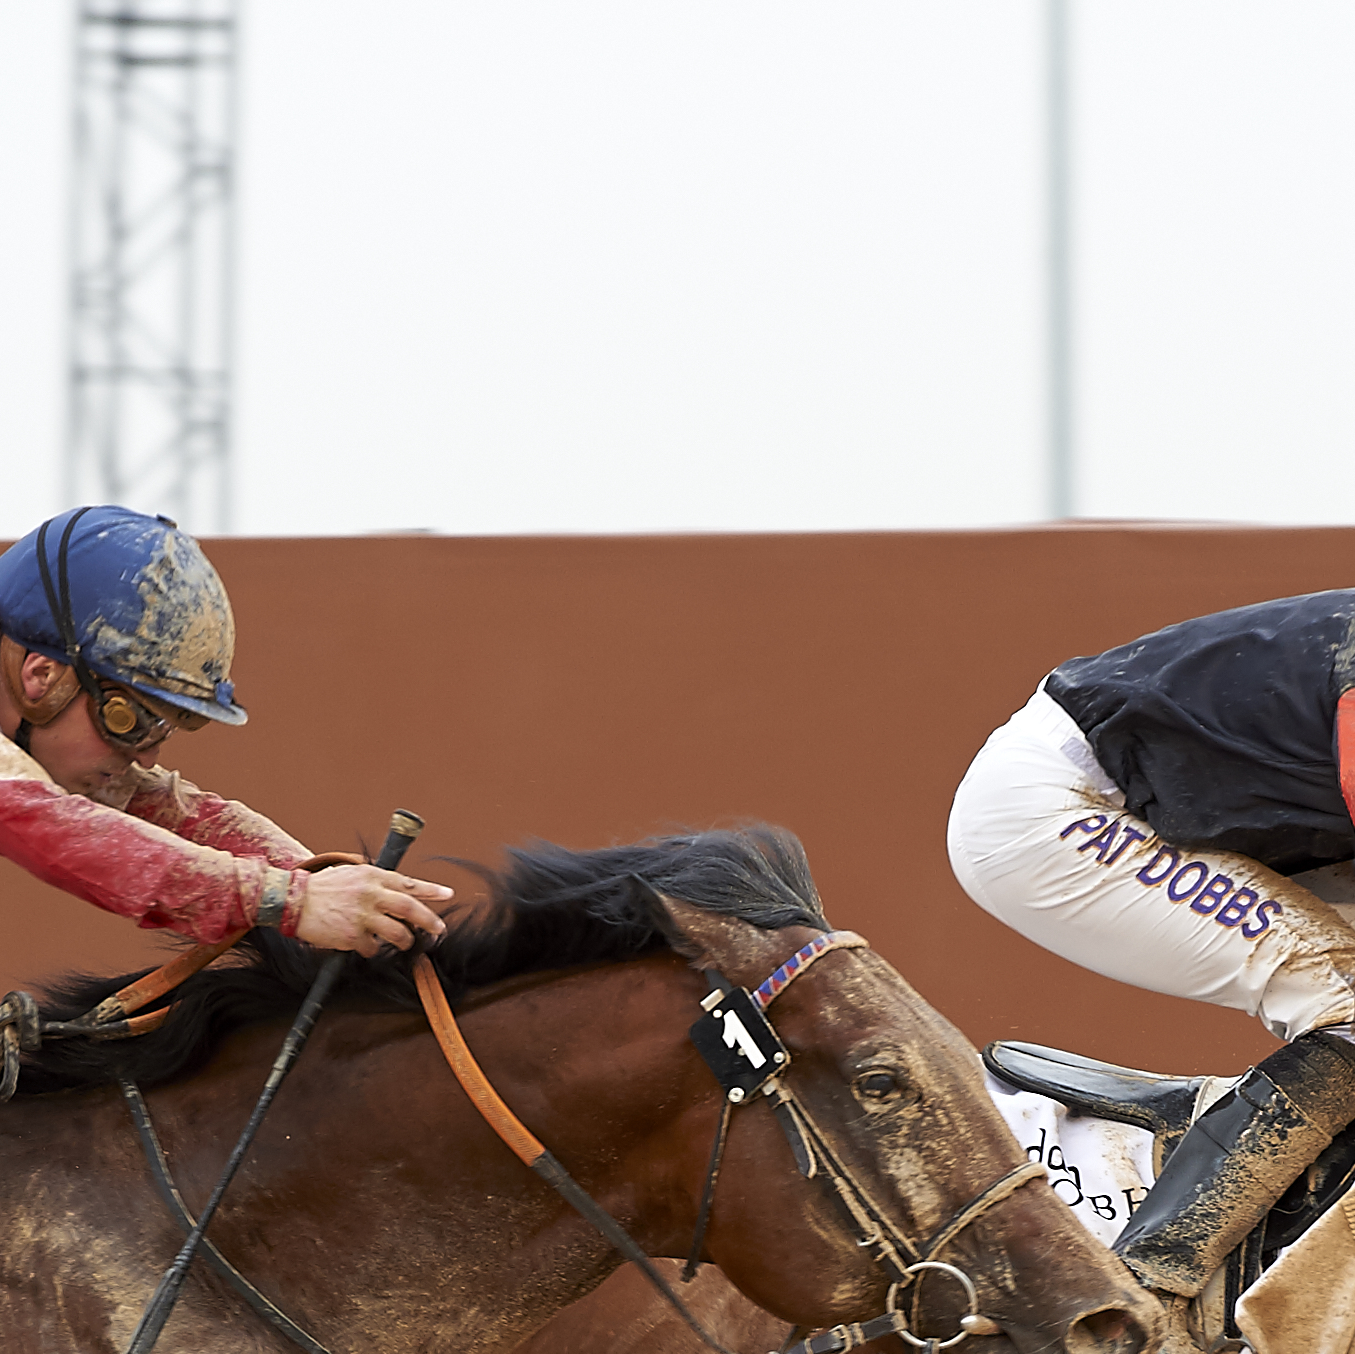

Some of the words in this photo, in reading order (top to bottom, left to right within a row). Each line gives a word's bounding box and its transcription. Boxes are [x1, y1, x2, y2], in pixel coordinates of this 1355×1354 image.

[1059, 814, 1147, 868] PAT
[1136, 844, 1284, 941] DOBBS
[722, 1009, 767, 1069] 1
[1051, 1178, 1151, 1221] OBH
